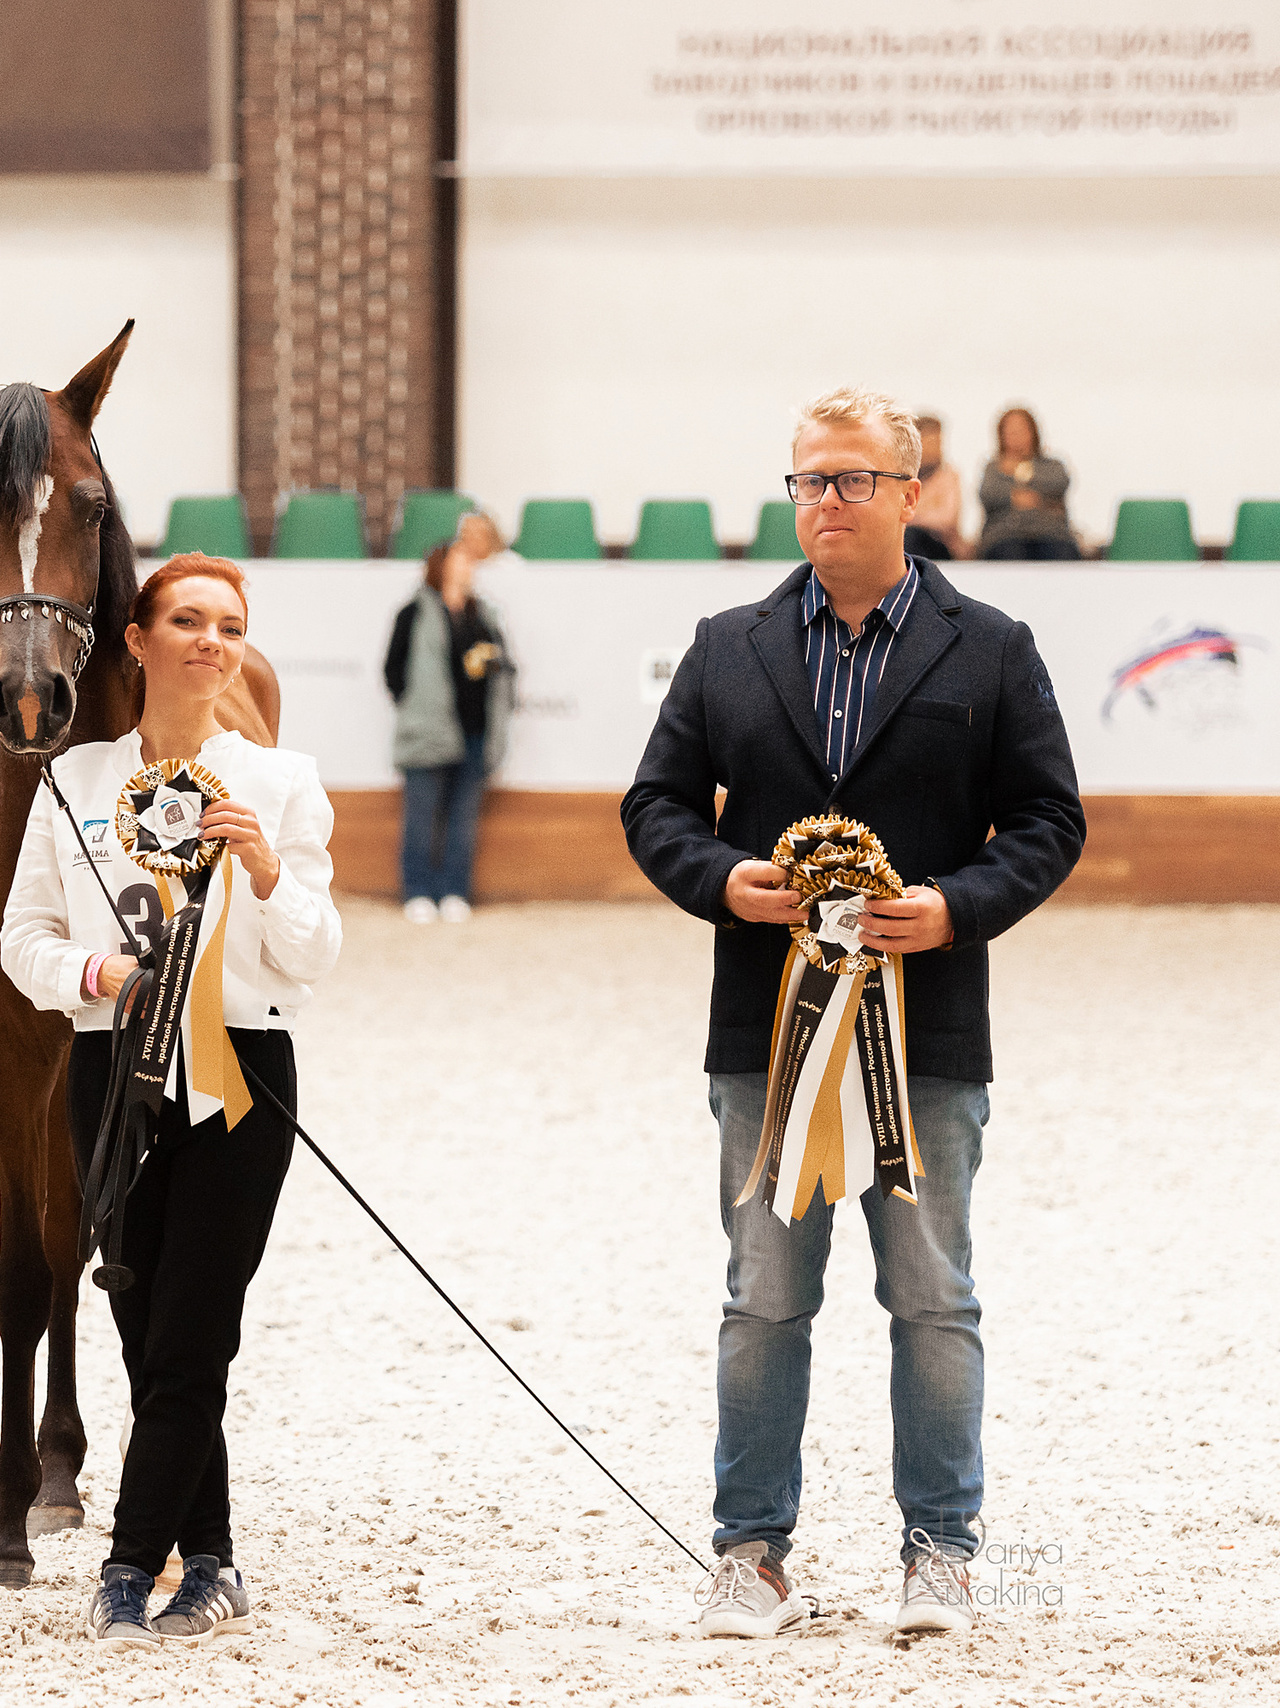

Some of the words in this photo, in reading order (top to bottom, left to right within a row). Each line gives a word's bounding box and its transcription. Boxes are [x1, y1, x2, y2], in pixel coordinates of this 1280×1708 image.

[73, 849, 109, 861] MAIMA
[160, 953, 173, 984] России
[148, 985, 167, 1034] Чемпионат
[158, 1023, 173, 1064] арабской
[168, 959, 186, 1021] чистокровной
[181, 923, 193, 957] породы
[874, 1004, 884, 1038] породы
[142, 1035, 155, 1061] XVIII
[796, 1026, 810, 1060] породы
[866, 1039, 875, 1070] России
[879, 1040, 892, 1102] чистокровной
[870, 1072, 881, 1120] Чемпионат
[876, 1122, 887, 1147] XVIII
[886, 1104, 899, 1144] арабской
